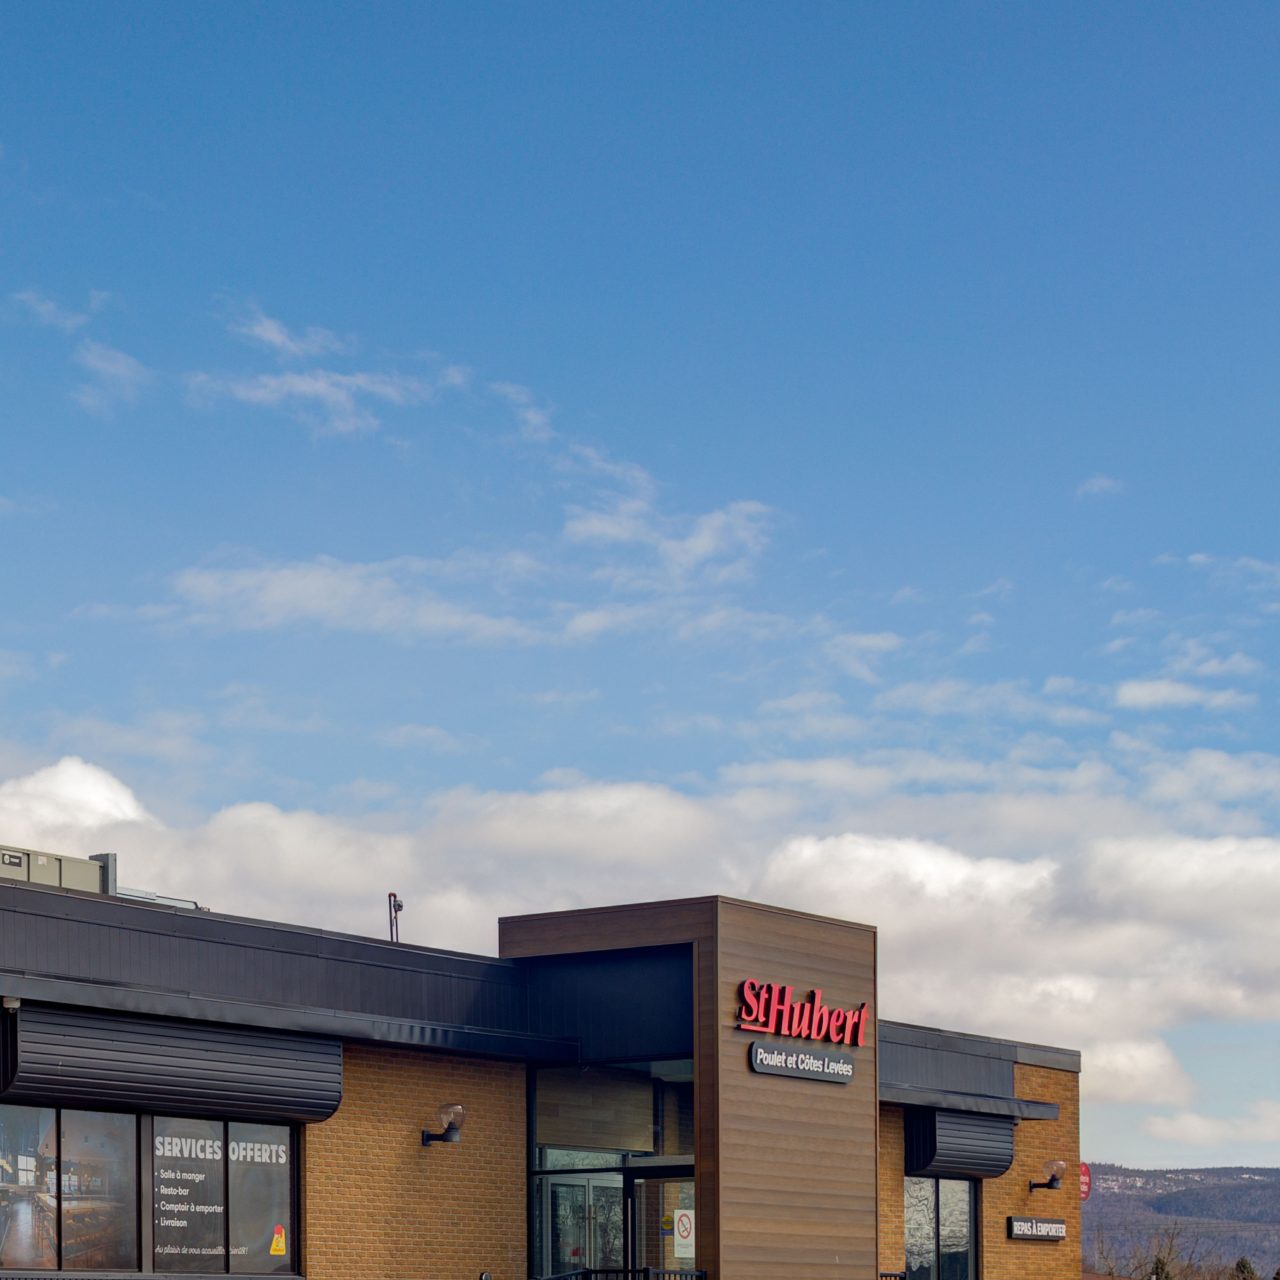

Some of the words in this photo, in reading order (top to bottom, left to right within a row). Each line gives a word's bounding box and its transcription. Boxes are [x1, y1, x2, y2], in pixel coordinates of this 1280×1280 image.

[756, 1048, 786, 1066] Poulet
[786, 1054, 797, 1069] et
[797, 1053, 823, 1072] Côtes
[823, 1057, 853, 1076] Levées
[155, 1136, 222, 1160] SERVICES
[228, 1141, 287, 1164] OFFERTS
[160, 1169, 175, 1179] Salle
[176, 1170, 181, 1180] à
[181, 1172, 205, 1182] manger
[160, 1185, 189, 1196] Resto-bar
[160, 1201, 189, 1213] Comptoir
[190, 1203, 195, 1212] à
[196, 1204, 224, 1215] emporter
[160, 1217, 188, 1228] Livraison
[1013, 1221, 1031, 1235] REPAS
[1032, 1219, 1037, 1235] À
[1037, 1222, 1066, 1237] EMPORTER
